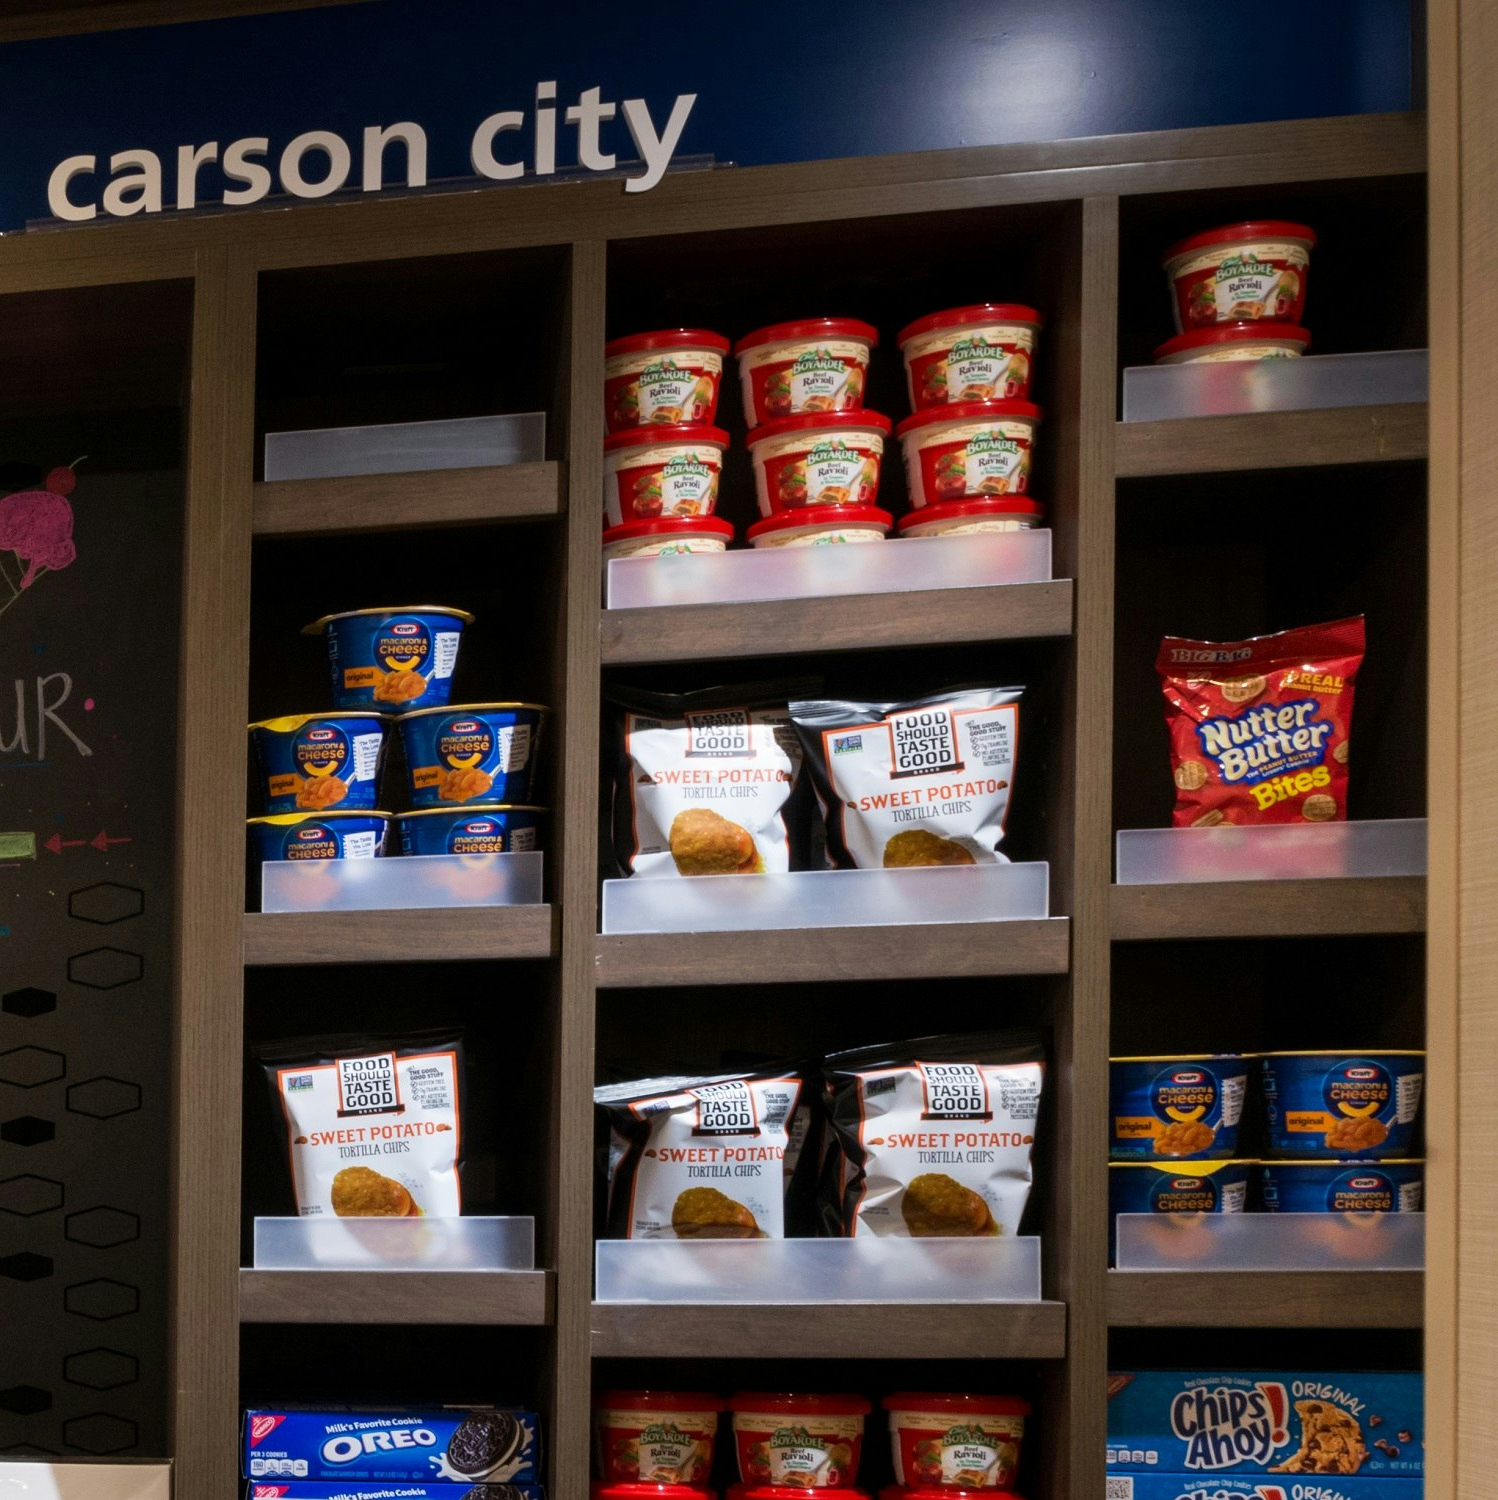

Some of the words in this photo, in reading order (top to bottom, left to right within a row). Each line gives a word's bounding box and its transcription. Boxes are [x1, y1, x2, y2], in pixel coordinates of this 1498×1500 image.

[48, 121, 429, 223] carson
[470, 80, 698, 193] city
[792, 357, 845, 375] BOYARDEE
[638, 368, 692, 386] BOYARDEE
[803, 376, 834, 387] Ravioli
[649, 386, 681, 397] Ravioli
[1300, 672, 1343, 687] REAL
[895, 711, 947, 731] FOOD
[1200, 701, 1315, 754] Nutter
[896, 725, 949, 741] SHOULD
[897, 739, 949, 754] TASTE
[1219, 724, 1329, 781] Butter
[899, 749, 952, 769] GOOD
[683, 785, 728, 799] TORTILLA
[730, 785, 758, 798] CHIPS
[860, 792, 923, 812] SWEET
[926, 780, 997, 801] POTATO
[1250, 766, 1331, 811] Bites
[891, 804, 939, 822] TORTILLA
[941, 800, 971, 817] CHIPS
[343, 1058, 389, 1072] FOOD
[343, 1070, 391, 1082] SHOULD
[1177, 1074, 1198, 1083] Kraft
[1350, 1069, 1372, 1078] Kraft
[345, 1080, 391, 1095] TASTE
[932, 1084, 980, 1097] TASTE
[346, 1092, 393, 1108] GOOD
[930, 1097, 982, 1111] GOOD
[1118, 1121, 1151, 1132] original
[1289, 1117, 1324, 1126] original
[311, 1128, 367, 1147] SWEET
[371, 1122, 435, 1140] POTATO
[887, 1133, 950, 1148] SWEET
[954, 1133, 1022, 1147] POTATO
[338, 1144, 381, 1158] TORTILLA
[383, 1141, 410, 1154] CHIPS
[1292, 1381, 1366, 1416] ORIGINAL
[1173, 1390, 1266, 1438] Chips
[325, 1422, 354, 1434] Milk's
[353, 1420, 391, 1432] Favorite
[392, 1417, 423, 1426] Cookie
[323, 1429, 437, 1463] OREO
